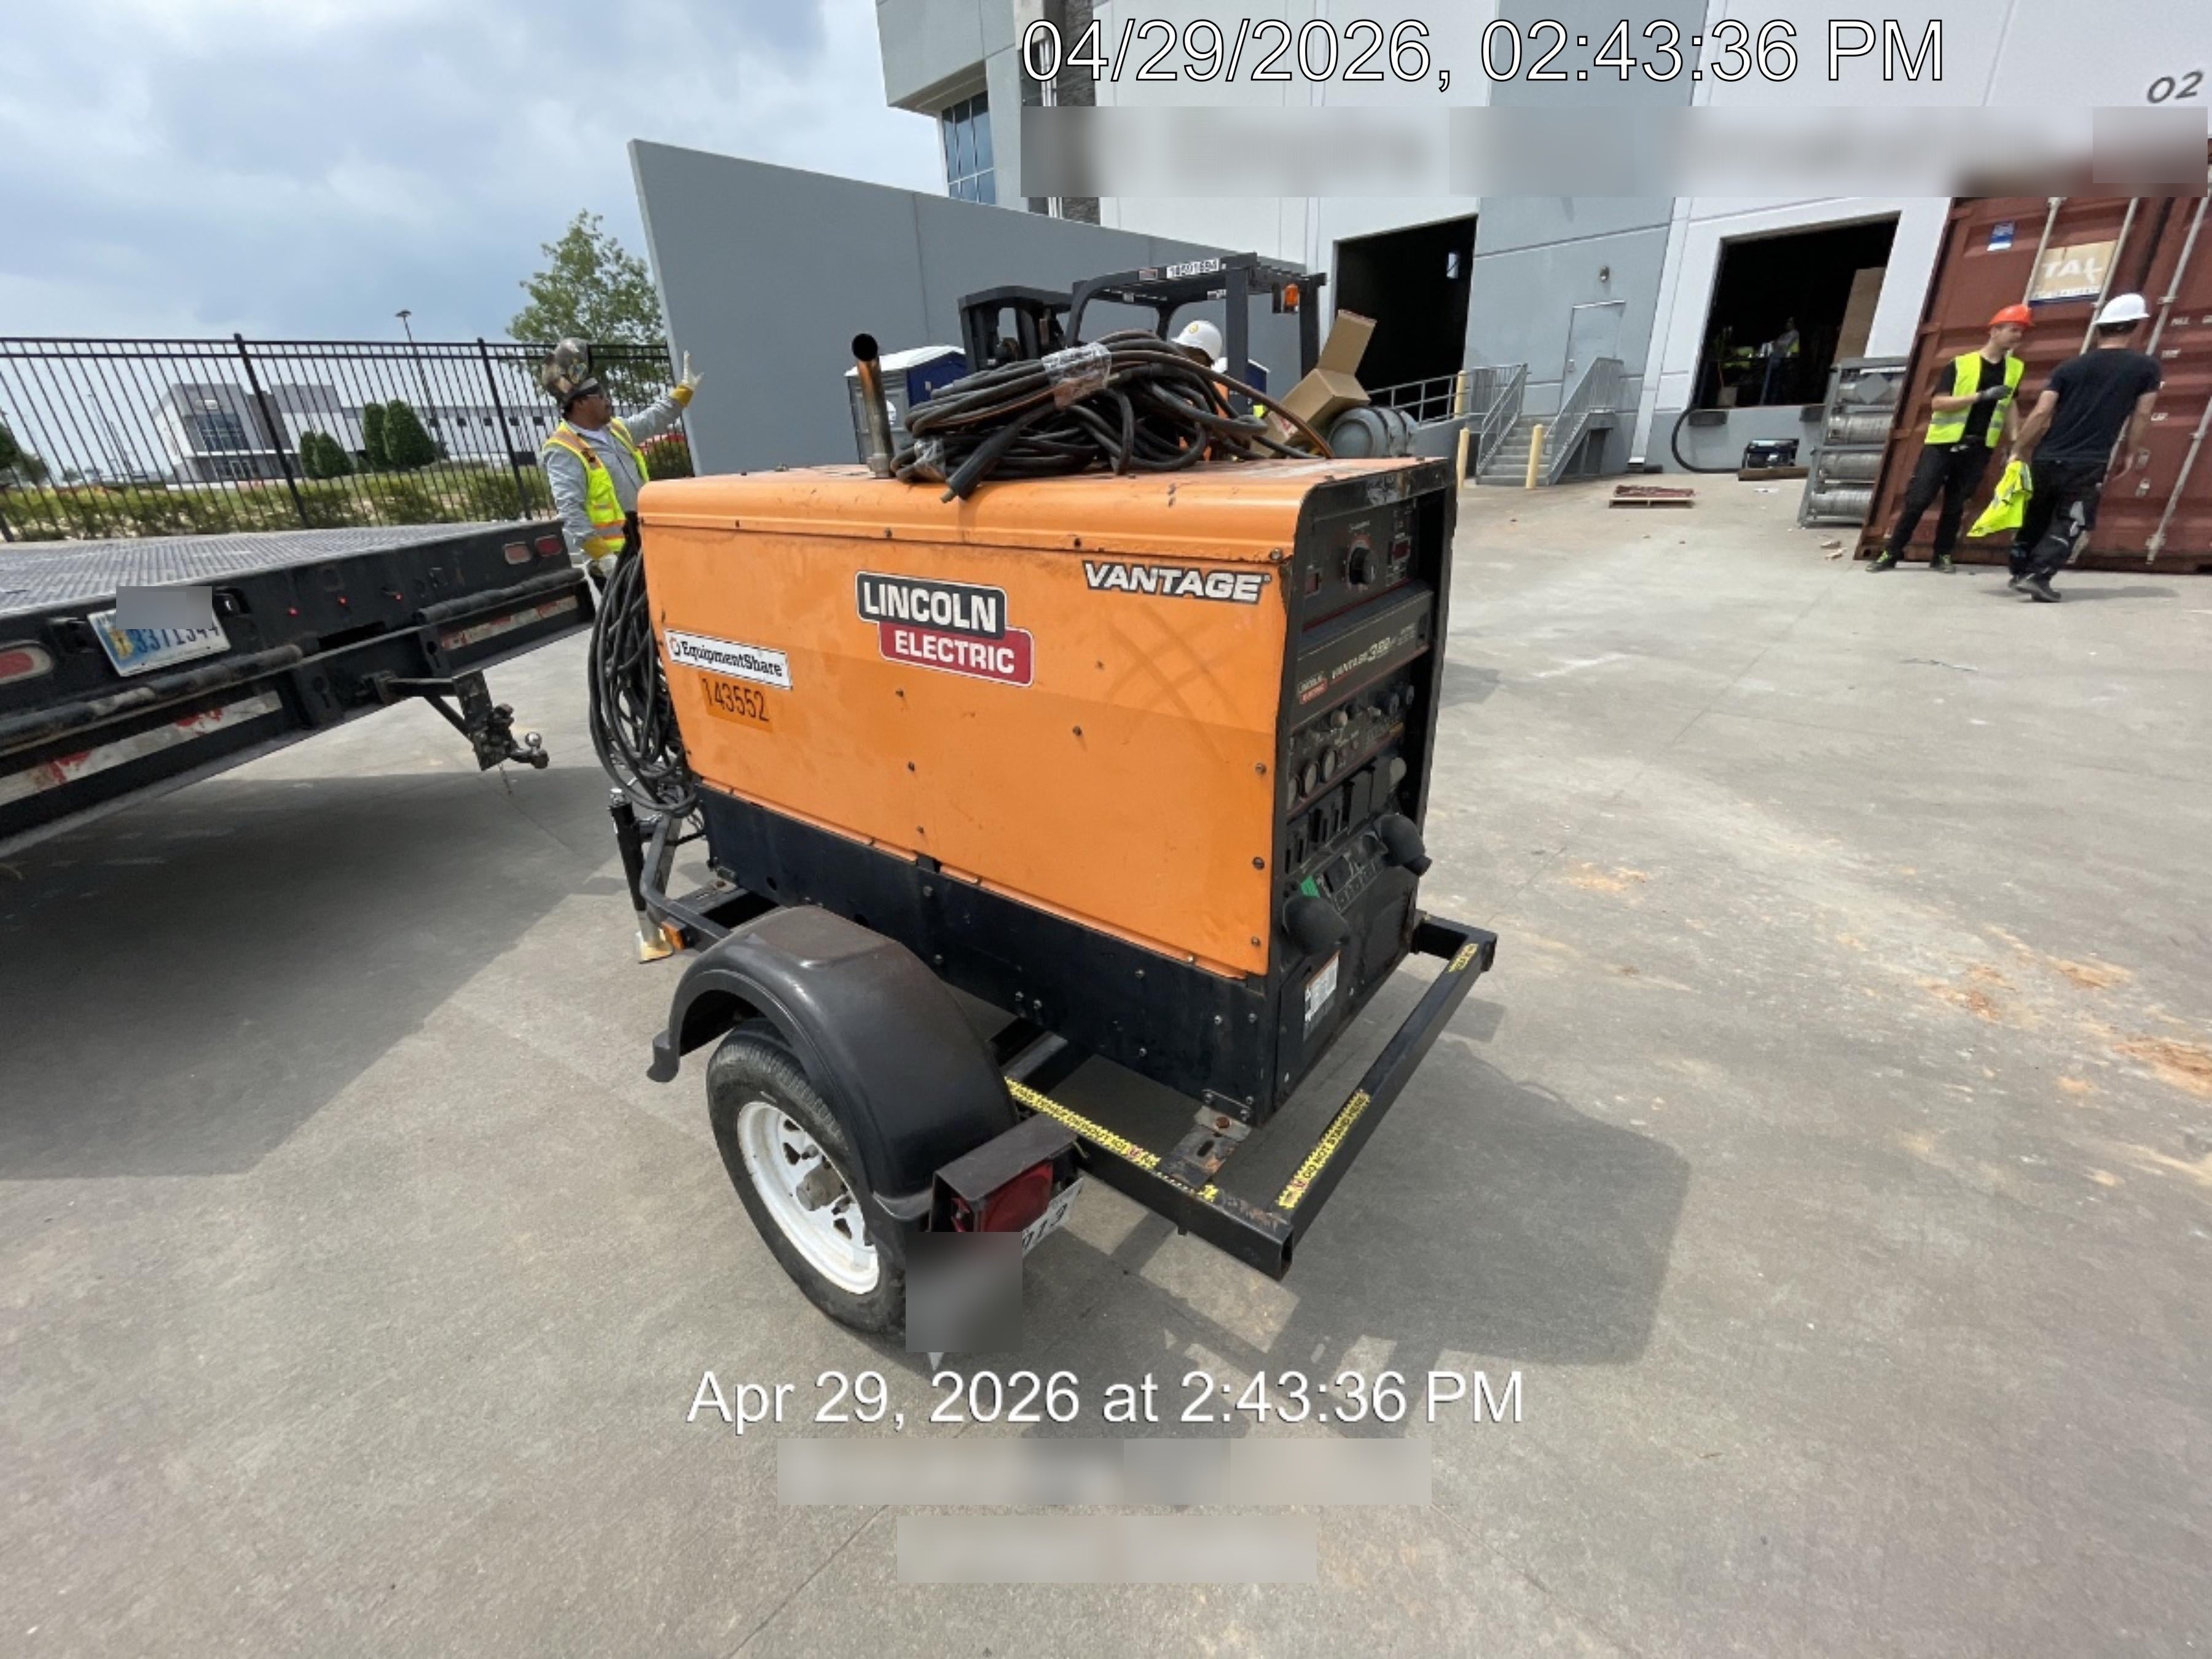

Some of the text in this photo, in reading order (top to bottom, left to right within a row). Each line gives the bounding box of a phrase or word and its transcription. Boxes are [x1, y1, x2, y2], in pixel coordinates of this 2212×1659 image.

[2147, 70, 2203, 104] 02
[863, 581, 997, 633] LINCOLN
[681, 641, 782, 677] EquipmentShare
[895, 630, 1015, 674] ELECTRIC
[702, 678, 770, 721] 143552
